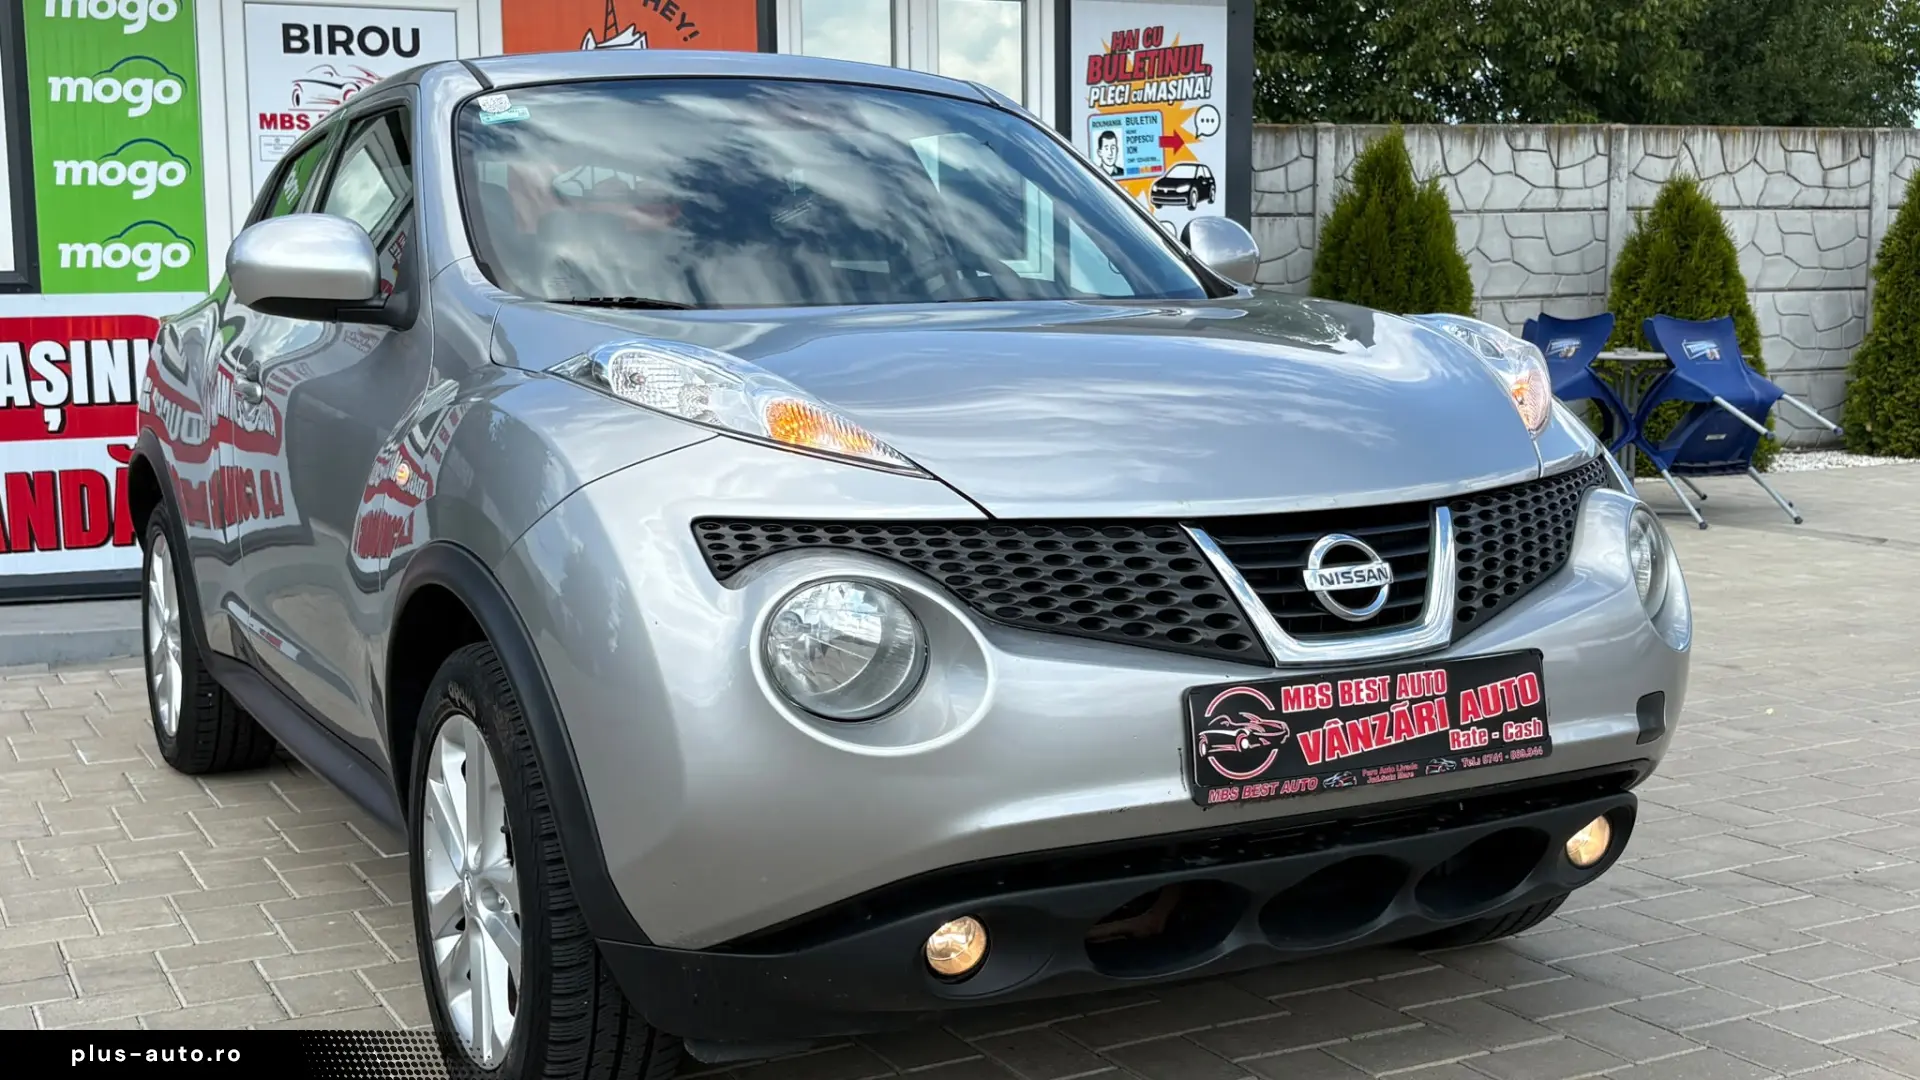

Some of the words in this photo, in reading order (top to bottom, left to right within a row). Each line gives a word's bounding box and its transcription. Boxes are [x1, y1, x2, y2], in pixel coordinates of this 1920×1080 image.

[45, 0, 177, 34] mogo
[281, 22, 420, 58] BIROU
[1111, 29, 1140, 51] HAI
[1142, 26, 1164, 48] CU
[1086, 44, 1212, 85] BULETINUL,
[48, 76, 182, 118] mogo
[1088, 83, 1131, 108] PLECI
[259, 113, 311, 131] MBS
[1125, 115, 1158, 126] BULETIN
[1126, 135, 1155, 144] POPESCU
[53, 160, 187, 200] mogo
[58, 242, 191, 282] mogo
[1318, 567, 1389, 586] NISSAN
[1281, 683, 1333, 713] MBS
[1338, 675, 1390, 707] BEST
[1396, 669, 1448, 699] AUTO
[1459, 671, 1541, 725] AUTO
[1449, 728, 1489, 750] Rate
[1502, 717, 1543, 742] Cash
[1208, 787, 1239, 803] MBS
[1242, 781, 1279, 799] BEST
[1280, 777, 1318, 794] AUTO
